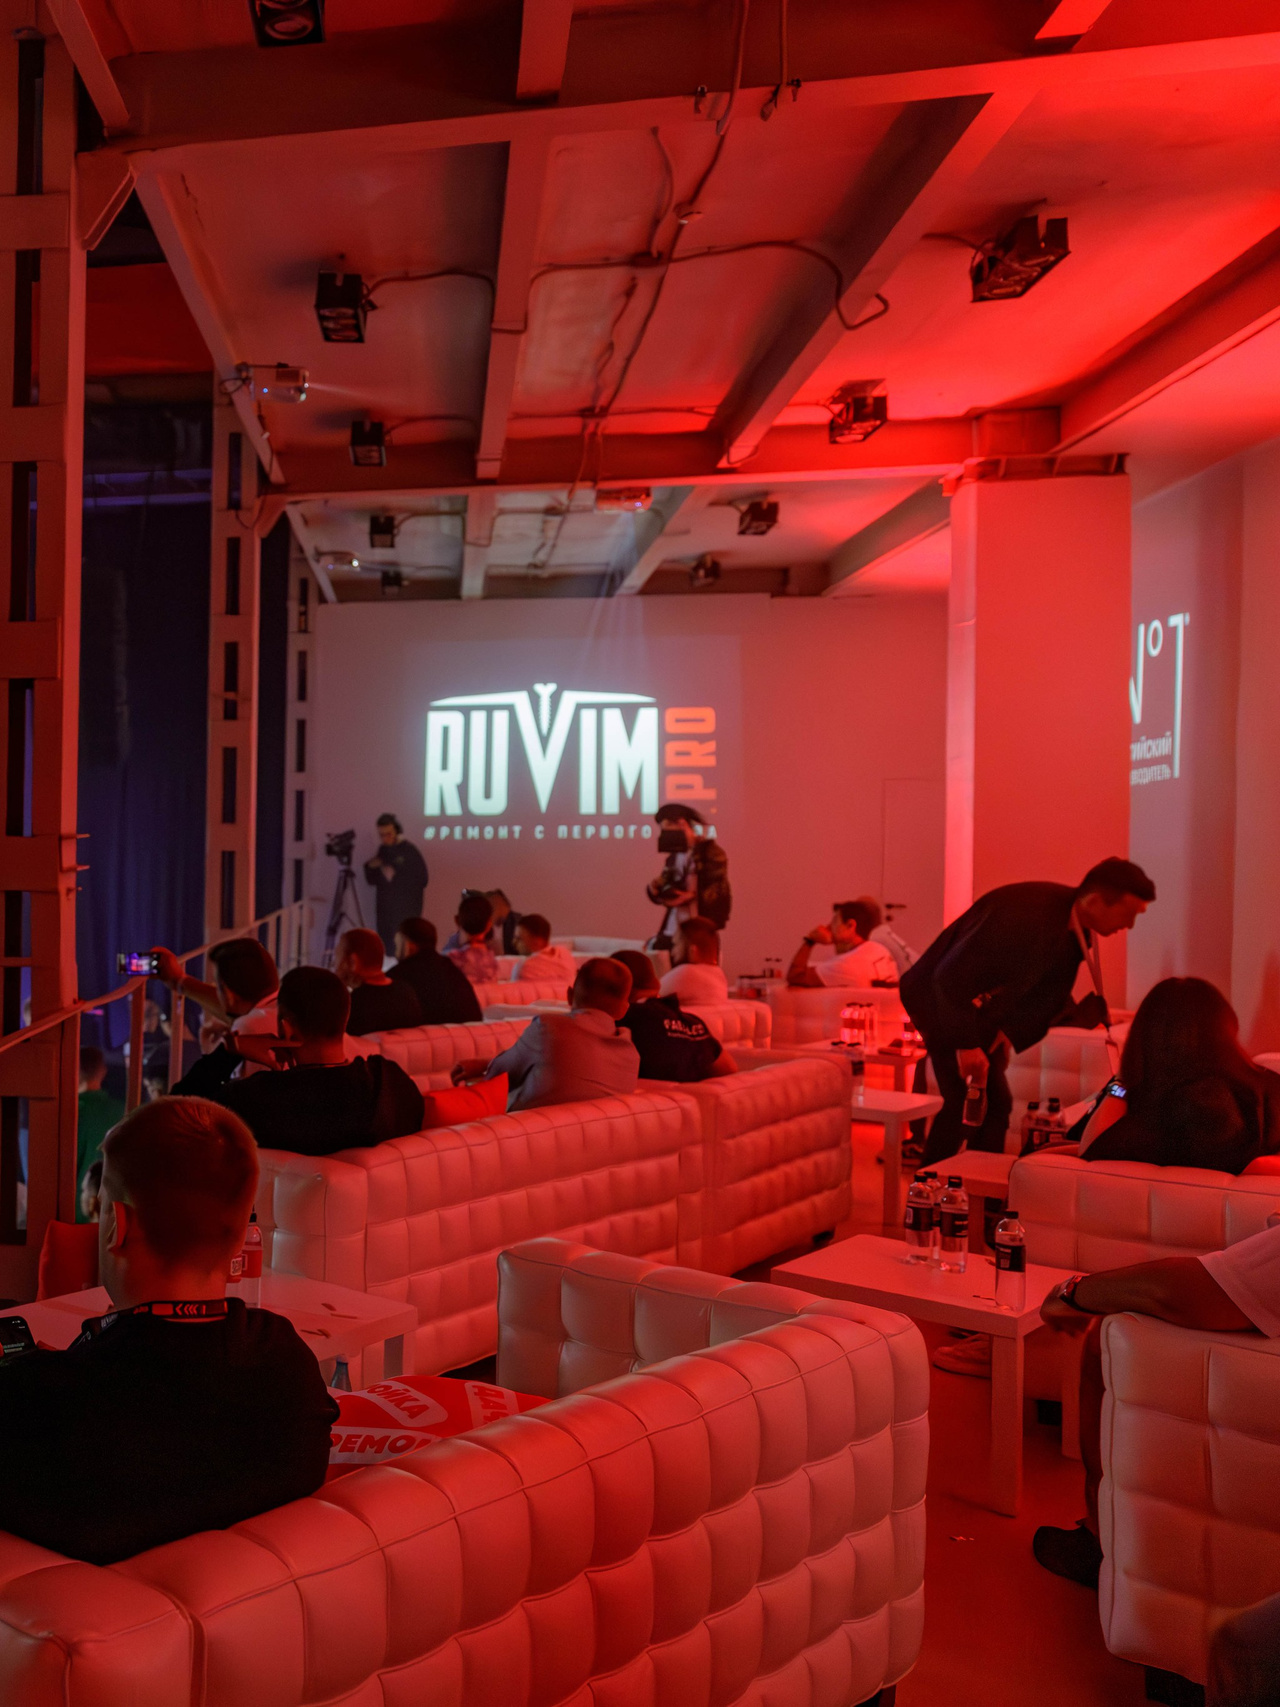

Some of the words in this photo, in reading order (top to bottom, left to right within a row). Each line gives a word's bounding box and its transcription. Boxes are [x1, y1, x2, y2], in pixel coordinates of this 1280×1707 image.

[423, 689, 659, 817] RUVIM
[1131, 731, 1172, 762] ИЙСКИЙ
[424, 824, 522, 841] #РЕМОНТ
[557, 824, 652, 840] ПЕРВОГО
[366, 1383, 431, 1421] ОЙКА
